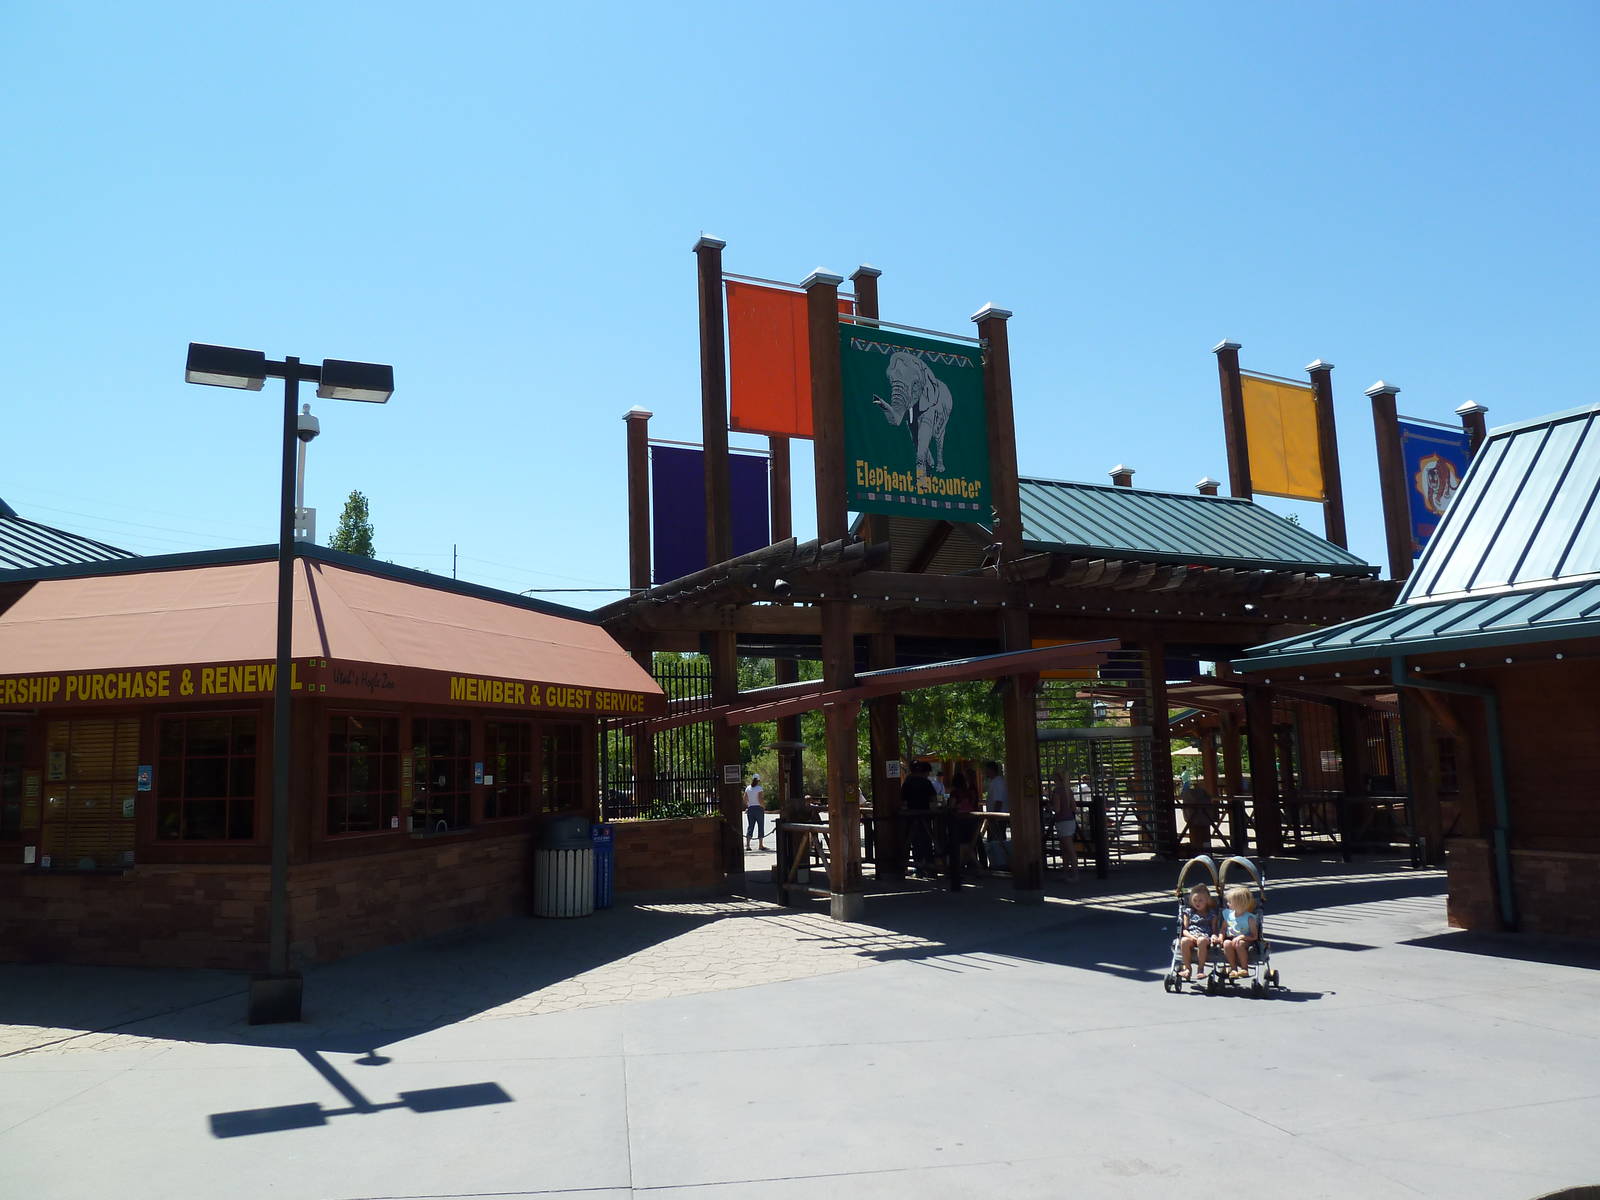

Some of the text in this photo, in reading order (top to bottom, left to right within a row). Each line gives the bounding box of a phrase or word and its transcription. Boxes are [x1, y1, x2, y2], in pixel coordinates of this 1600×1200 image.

[855, 459, 982, 498] Elephant Encounter
[65, 670, 171, 701] PURCHASE
[180, 668, 194, 696] &
[201, 663, 302, 695] RENEWL
[450, 676, 645, 713] MEMBER & GUEST SERVICE
